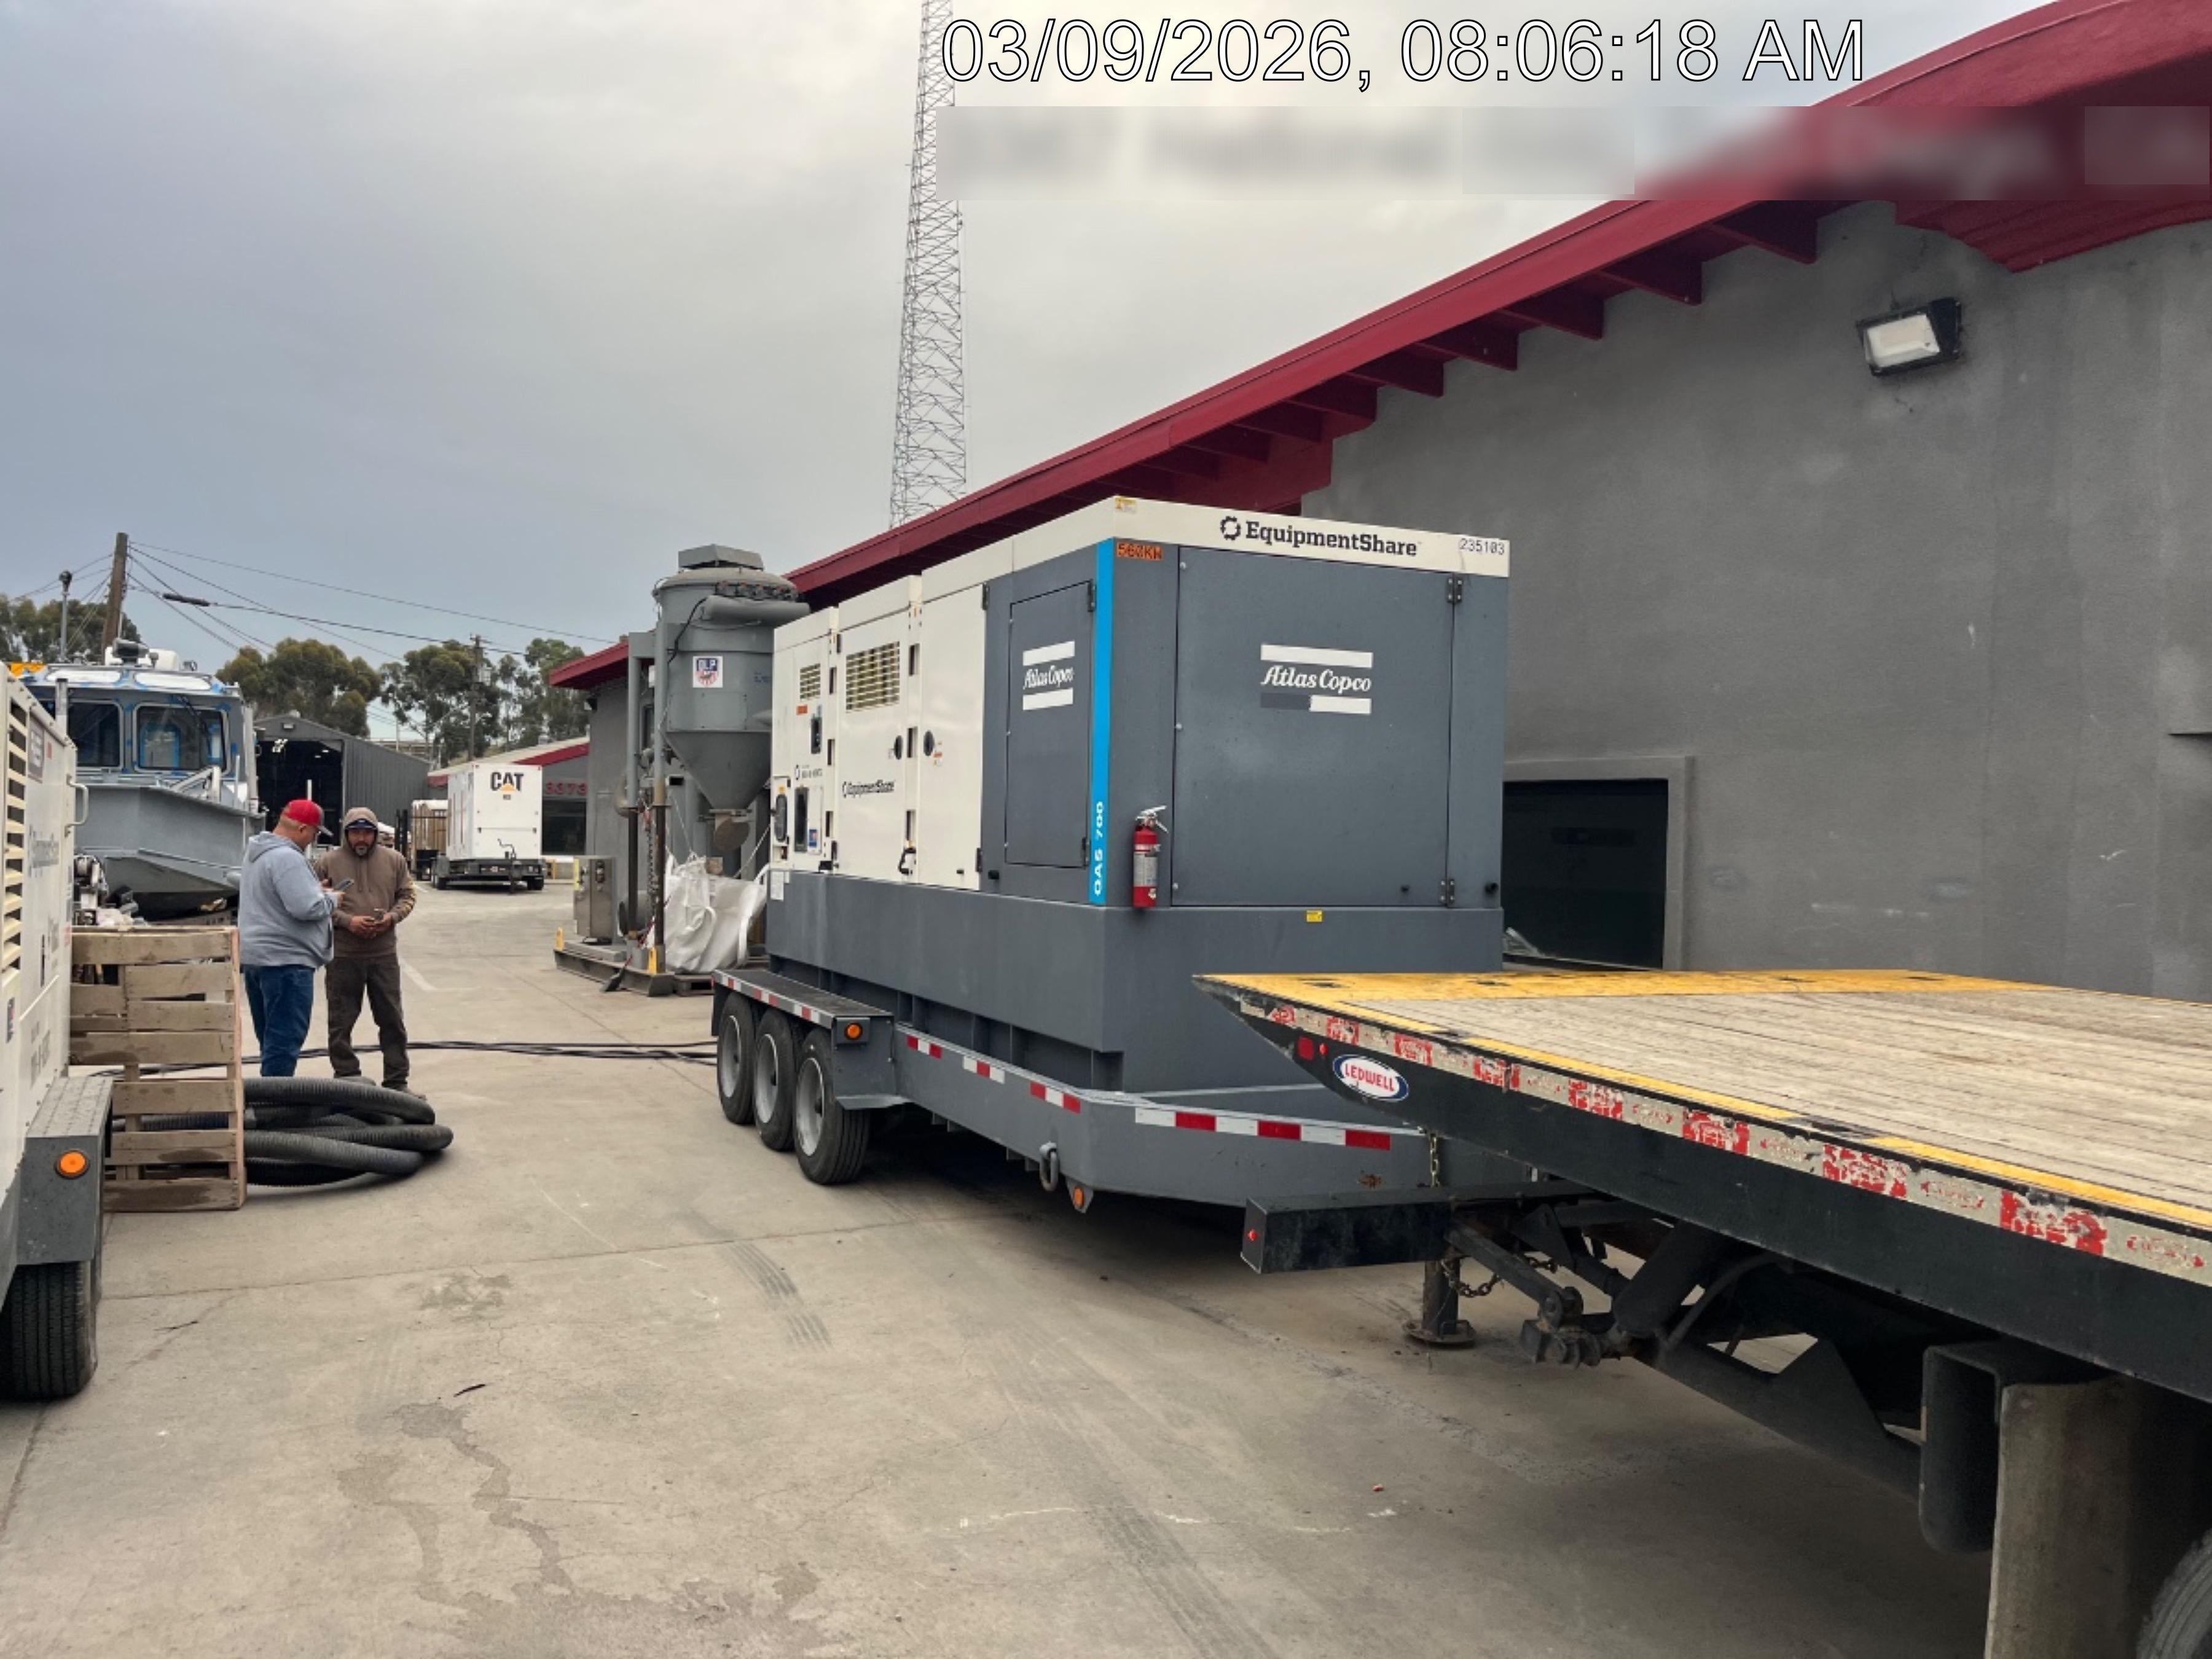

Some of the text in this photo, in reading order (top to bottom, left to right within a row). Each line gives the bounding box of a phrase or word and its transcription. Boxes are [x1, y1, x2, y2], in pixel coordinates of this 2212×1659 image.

[1245, 521, 1417, 556] EquipmentShare
[1459, 538, 1505, 555] 235103
[1023, 665, 1073, 690] Atlas Copco
[1260, 665, 1371, 694] Atlas Copco
[490, 771, 524, 791] CAT
[1094, 849, 1103, 896] QAS
[1345, 1063, 1395, 1092] LEDWELL
